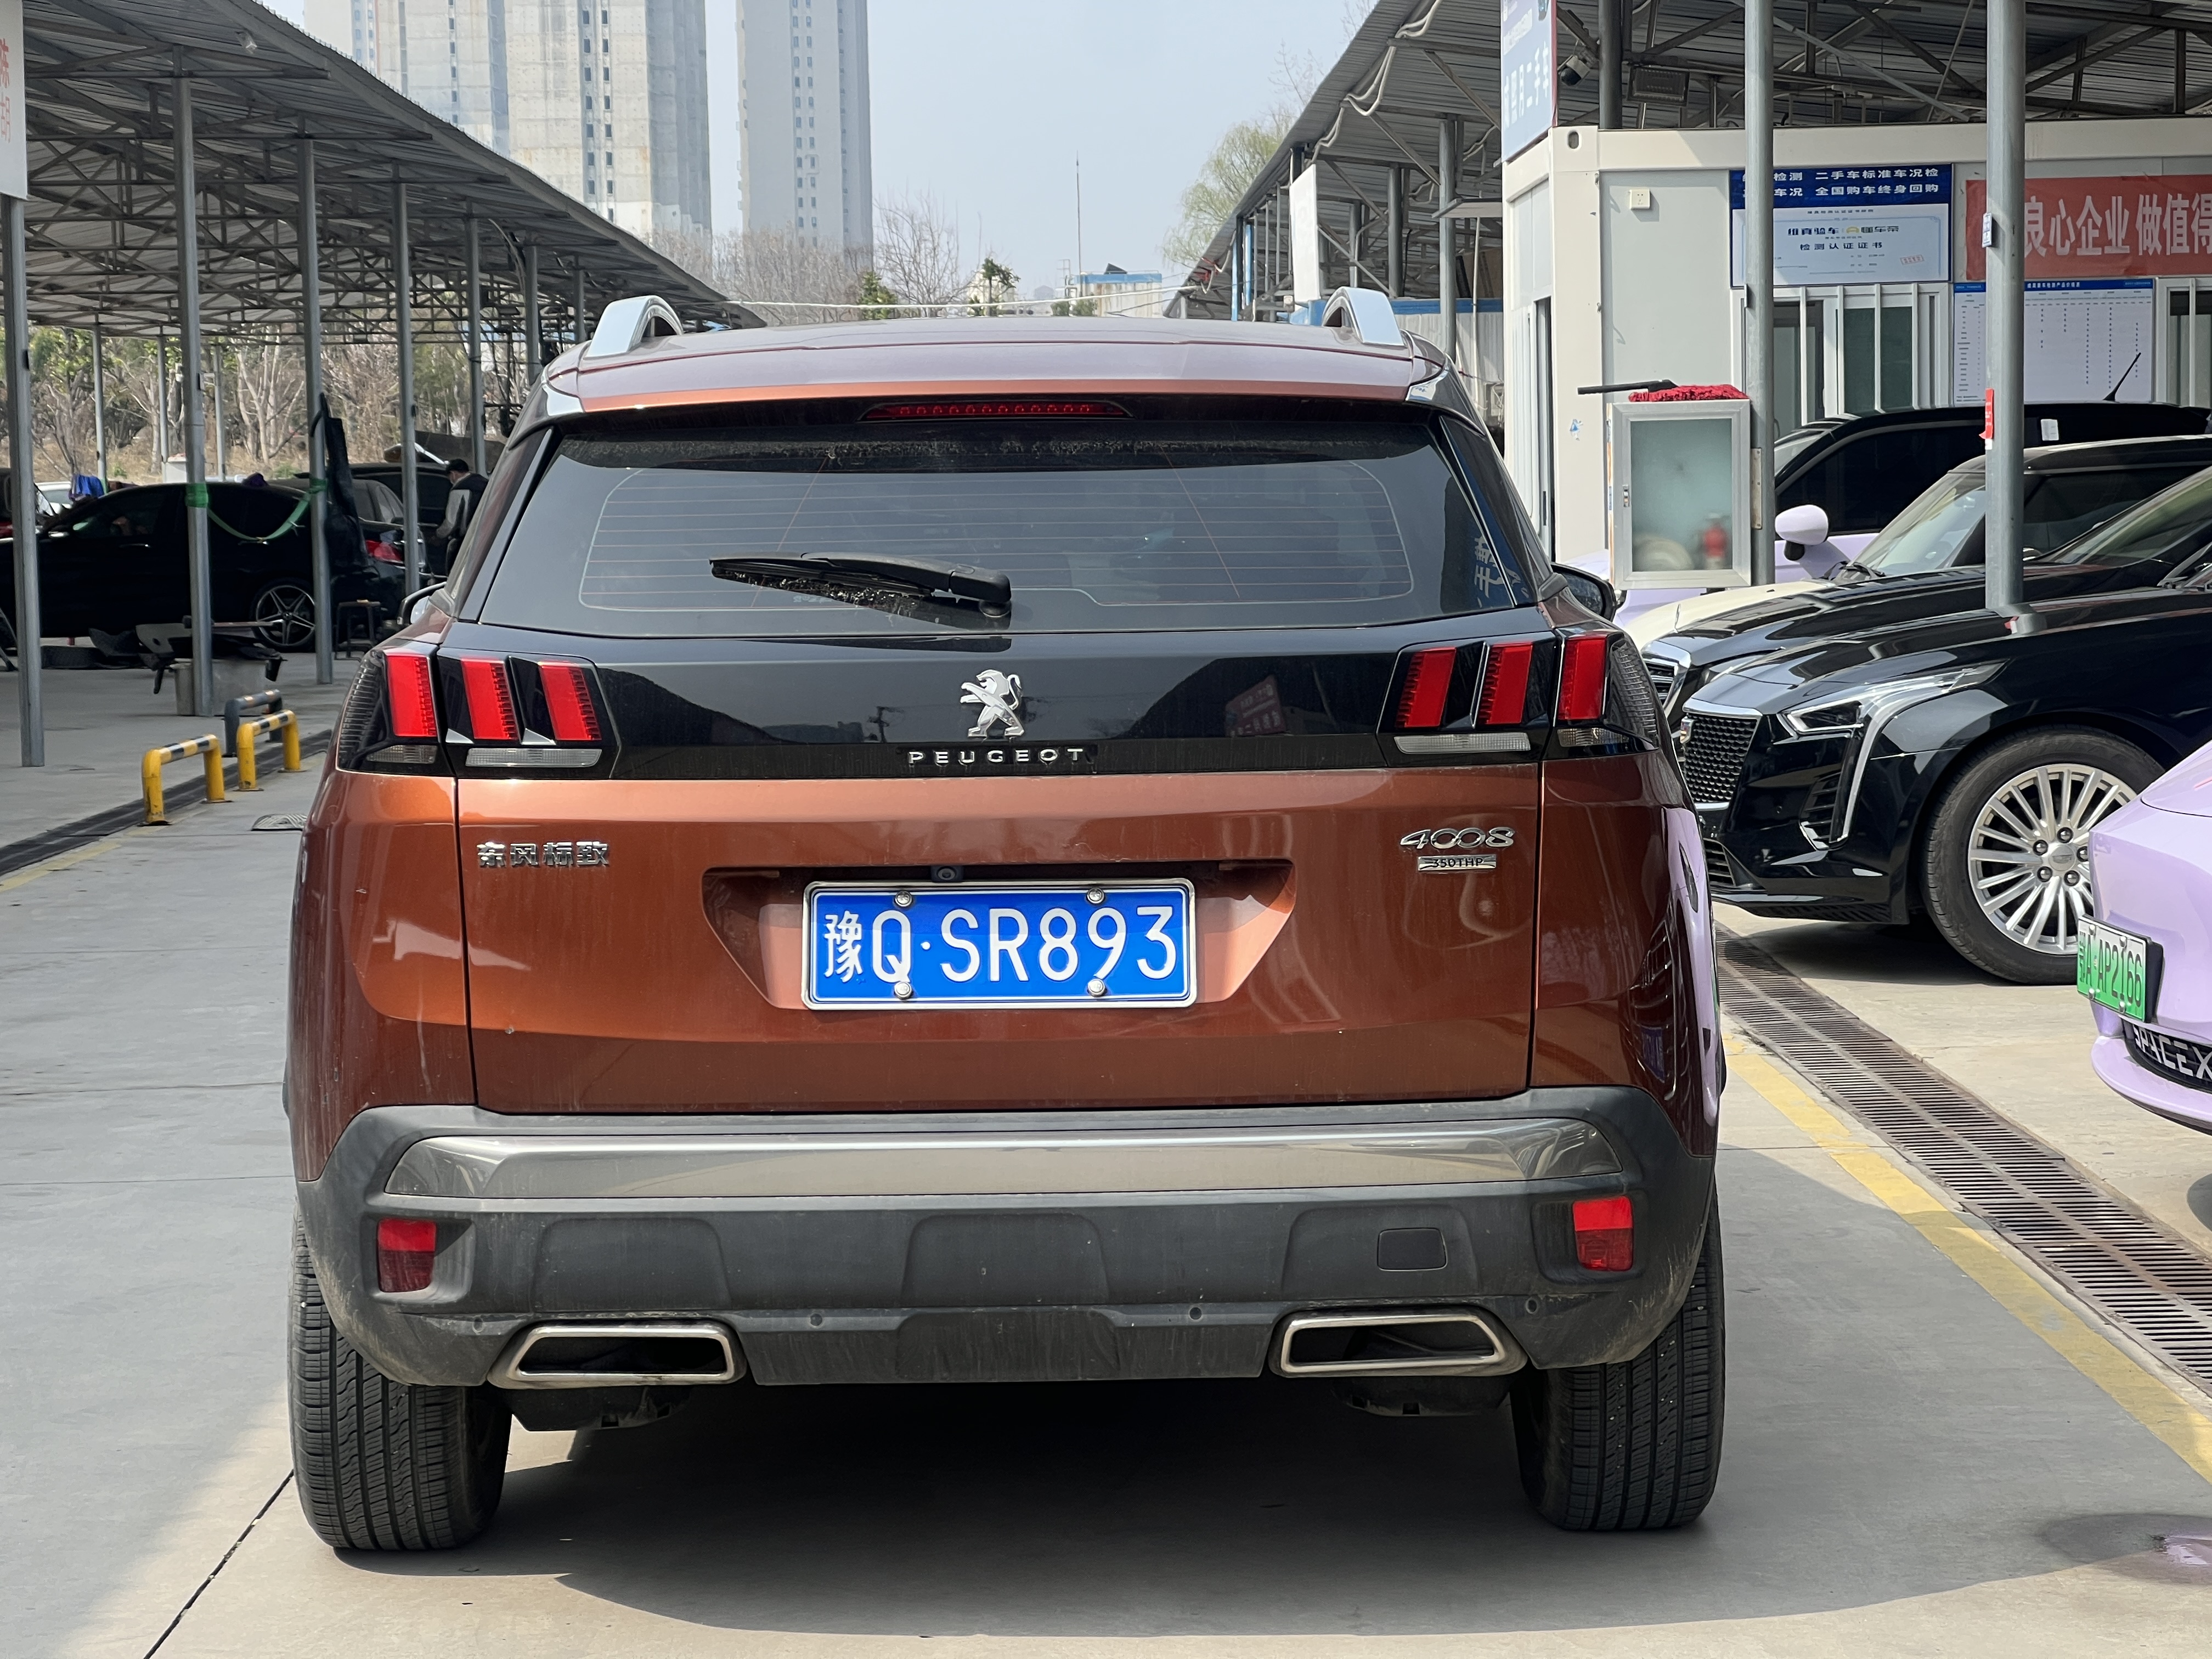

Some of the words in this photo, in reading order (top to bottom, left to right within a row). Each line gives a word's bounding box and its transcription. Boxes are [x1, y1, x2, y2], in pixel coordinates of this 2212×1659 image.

[1815, 168, 1939, 180] 二手车标准车况检
[1815, 184, 1939, 196] 全国购车终身回购
[2024, 195, 2130, 257] 良心企业
[1800, 241, 1882, 251] 检测认证证书
[909, 748, 1084, 764] PEUGEOT
[1400, 827, 1515, 849] 4008
[476, 841, 608, 866] 东风标致
[1432, 857, 1483, 868] 350THP
[2132, 1024, 2212, 1080] SPACEX
